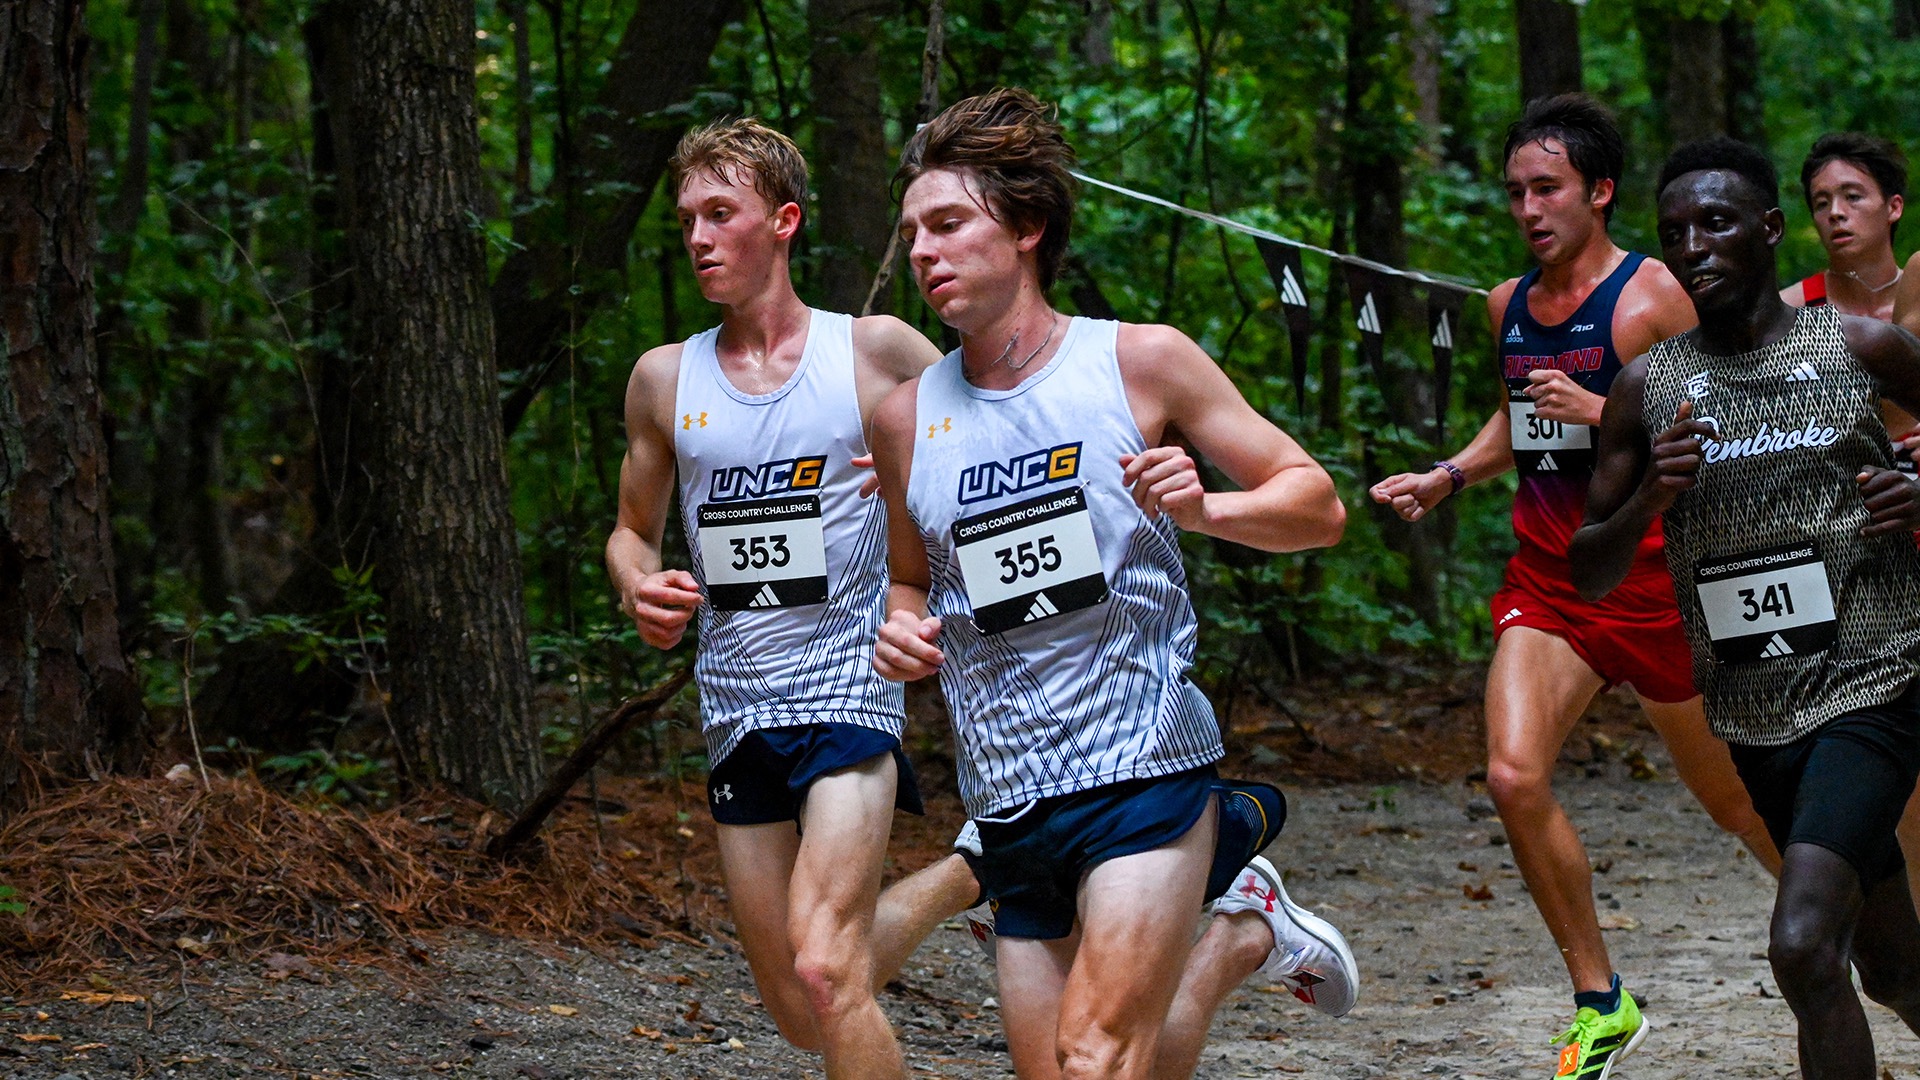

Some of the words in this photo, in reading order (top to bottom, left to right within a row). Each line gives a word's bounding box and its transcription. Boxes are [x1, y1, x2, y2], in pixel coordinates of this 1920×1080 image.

[1504, 346, 1604, 379] RICHMOND
[709, 455, 828, 502] UNCG
[958, 441, 1083, 505] UNCG
[703, 511, 727, 520] CROSS
[727, 507, 763, 519] COUNTRY
[764, 502, 813, 516] CHALLENGE
[959, 522, 988, 538] CROSS
[988, 510, 1027, 528] COUNTRY
[1026, 496, 1078, 517] CHALLENGE
[729, 534, 791, 571] 353
[994, 535, 1062, 584] 355
[1700, 564, 1727, 577] CROSS
[1727, 557, 1764, 571] COUNTRY
[1764, 548, 1814, 565] CHALLENGE
[1738, 582, 1794, 622] 341
